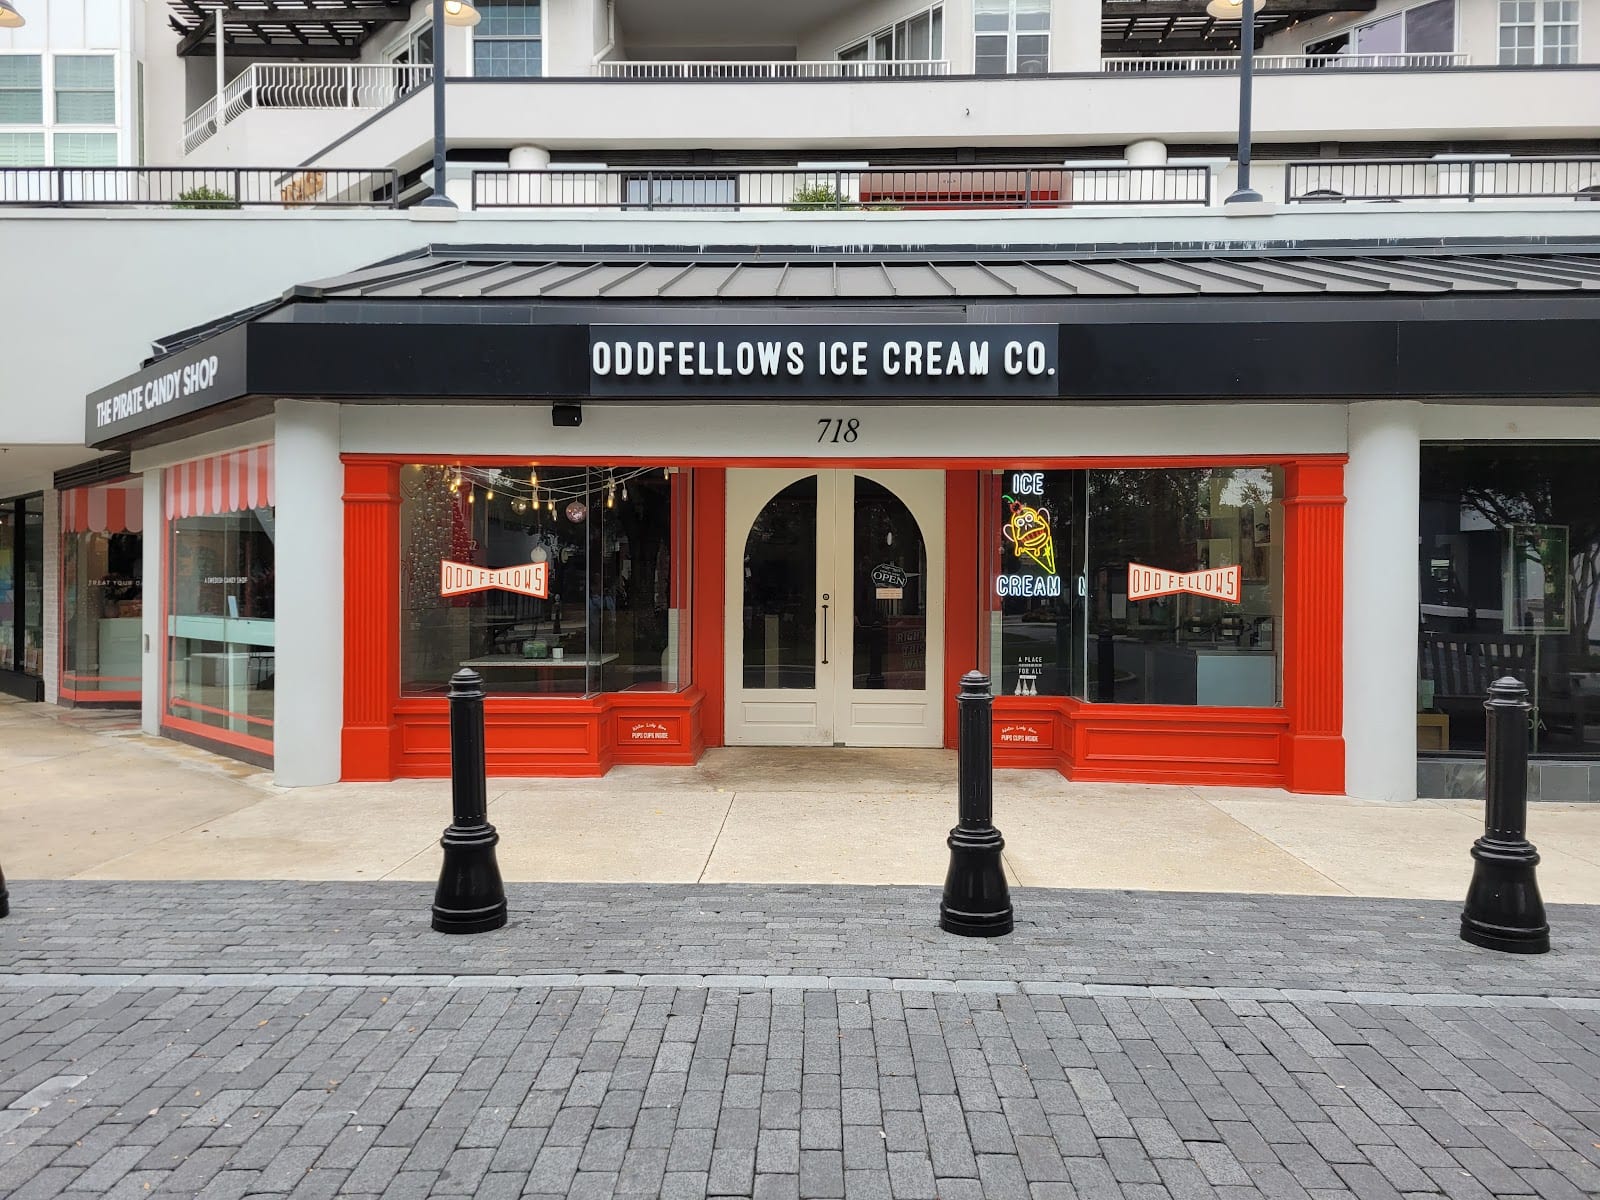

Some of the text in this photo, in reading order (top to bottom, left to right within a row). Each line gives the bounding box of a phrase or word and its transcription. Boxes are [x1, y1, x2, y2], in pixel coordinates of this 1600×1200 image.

[592, 341, 1056, 375] ODDFELLOWS ICE CREAM CO.
[96, 355, 218, 427] THE PIRATE CANDY SHOP
[817, 418, 860, 443] 718
[1012, 472, 1045, 495] ICE
[445, 565, 542, 592] ODD FELLOWS
[873, 571, 906, 587] OPEN
[996, 575, 1061, 597] CREAM
[1133, 569, 1234, 596] ODD FELLOWS
